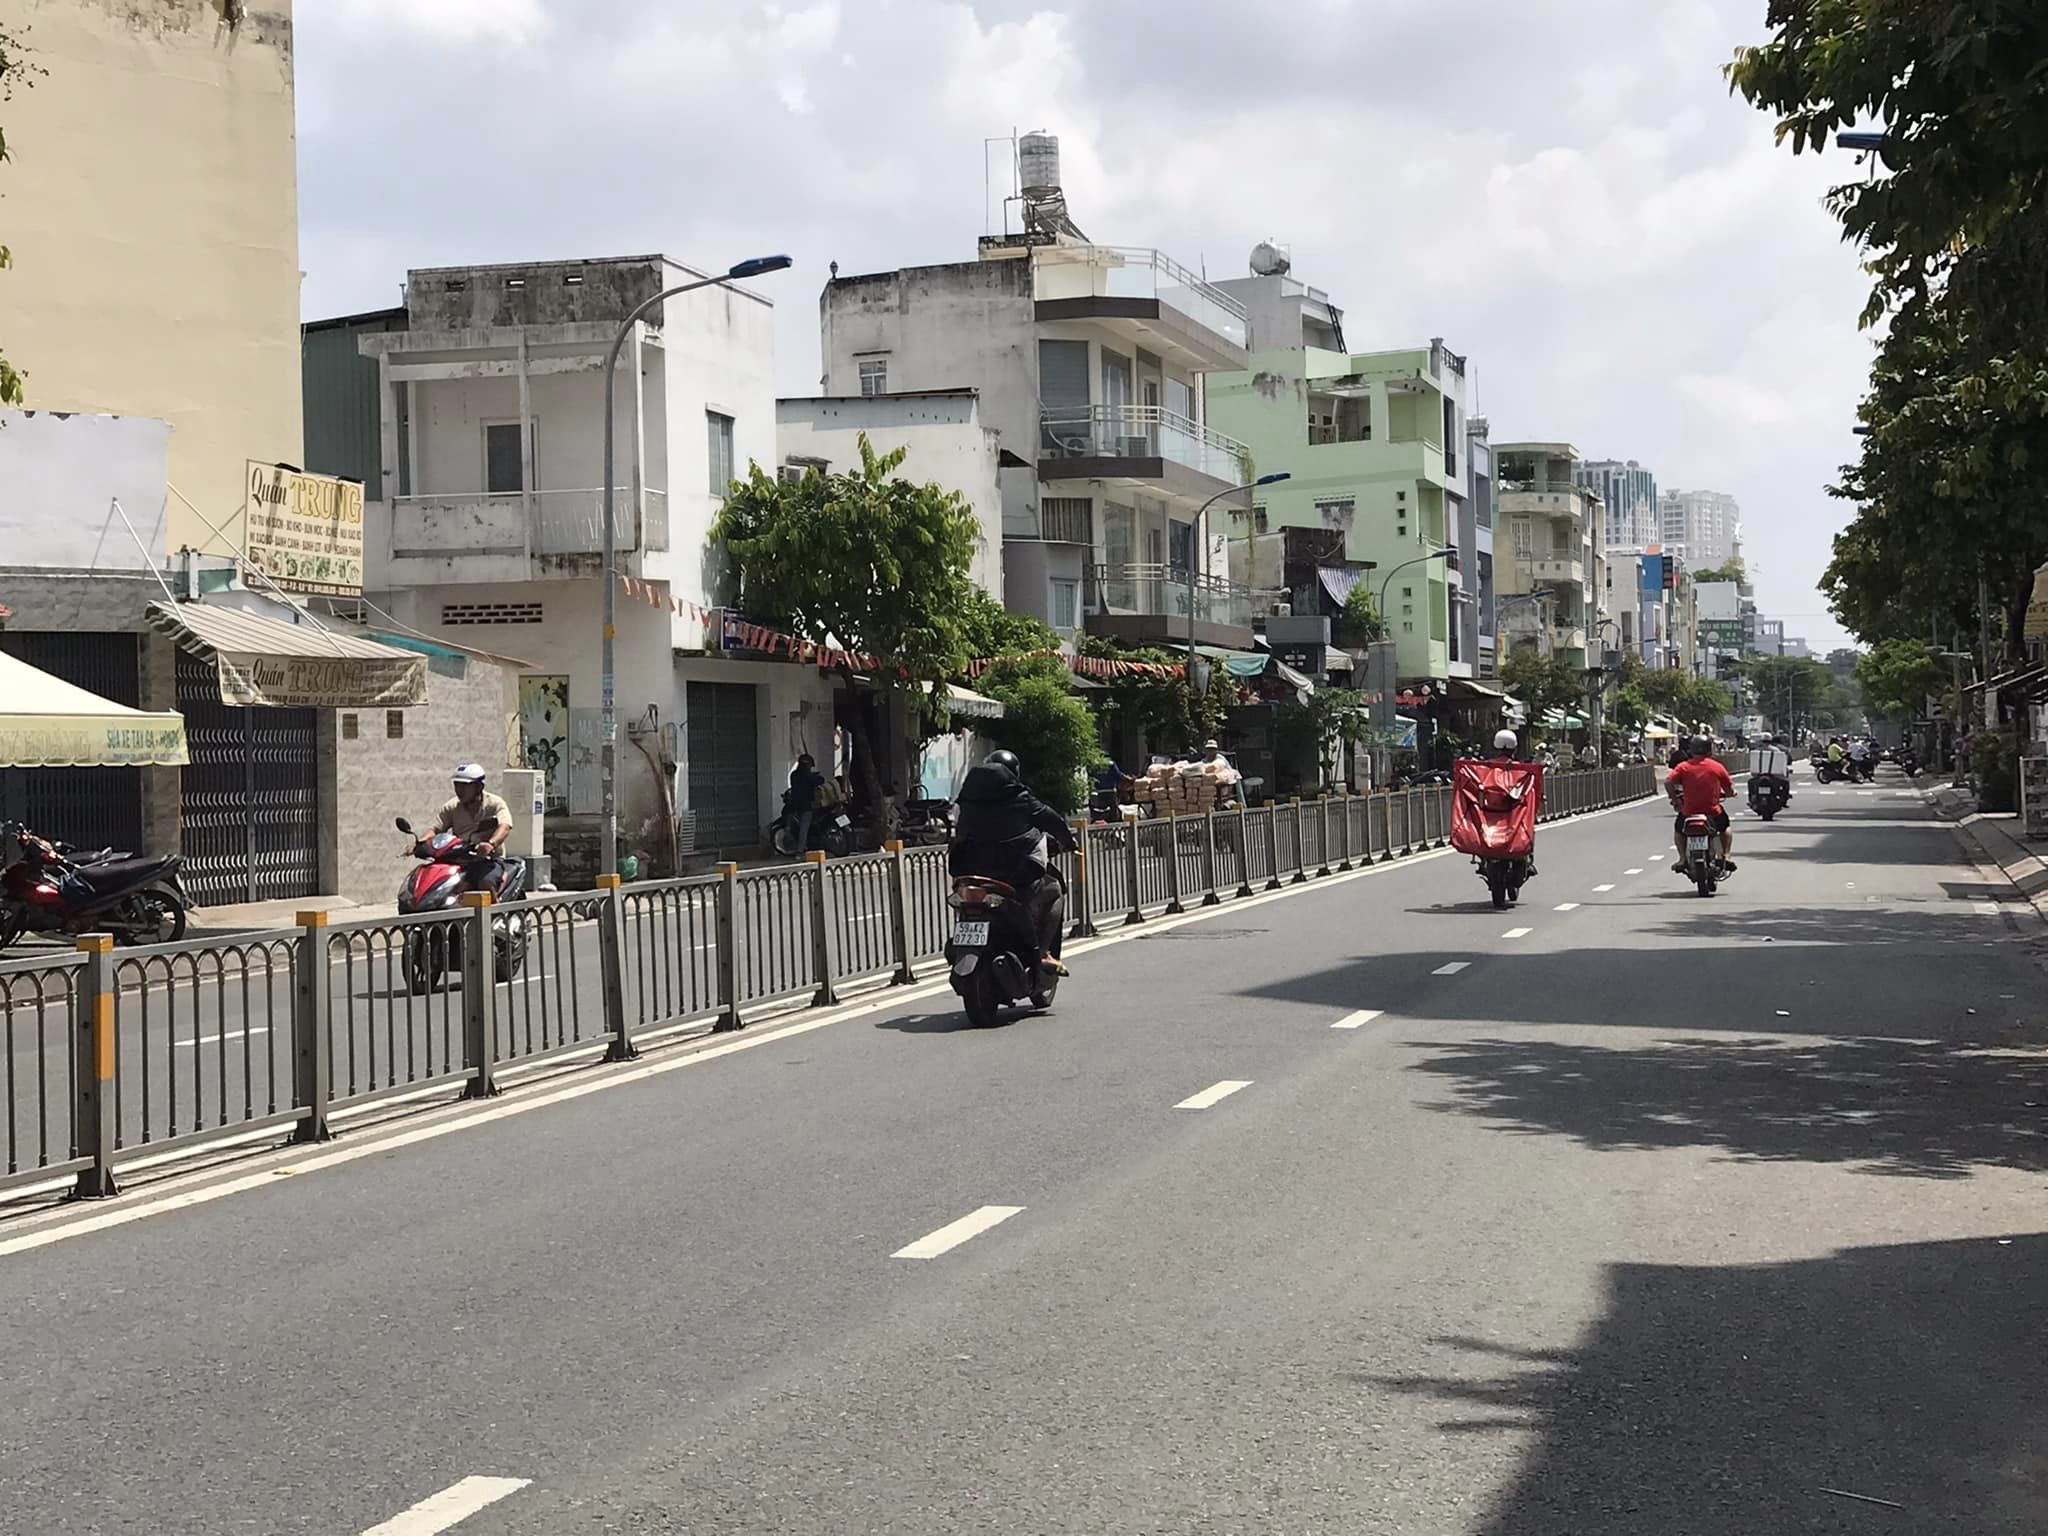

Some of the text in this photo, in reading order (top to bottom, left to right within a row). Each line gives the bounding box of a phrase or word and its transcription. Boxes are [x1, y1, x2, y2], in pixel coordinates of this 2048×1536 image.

[289, 474, 362, 524] TRUNG
[253, 658, 285, 690] Quán
[288, 659, 363, 693] TRUNG
